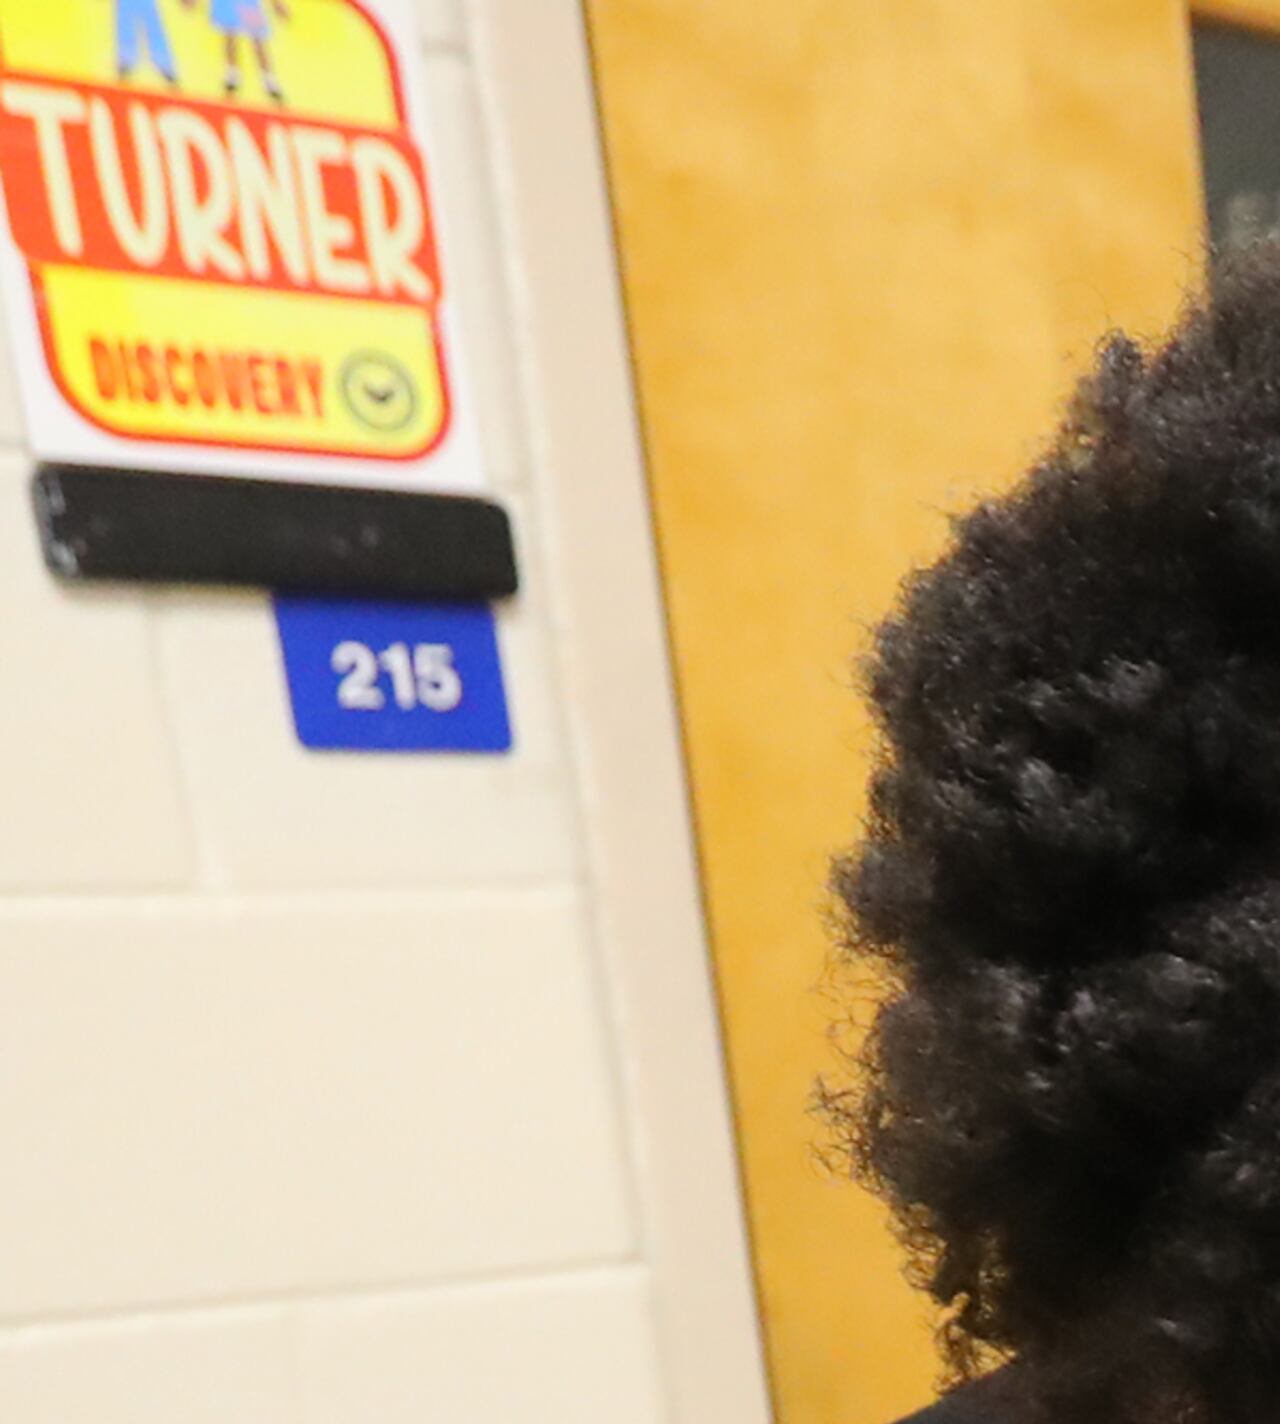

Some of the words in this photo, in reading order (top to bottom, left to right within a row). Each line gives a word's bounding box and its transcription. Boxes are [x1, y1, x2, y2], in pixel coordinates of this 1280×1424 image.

[4, 88, 434, 301] TURNER
[87, 336, 326, 420] DISCOVERY
[330, 640, 462, 713] 215
